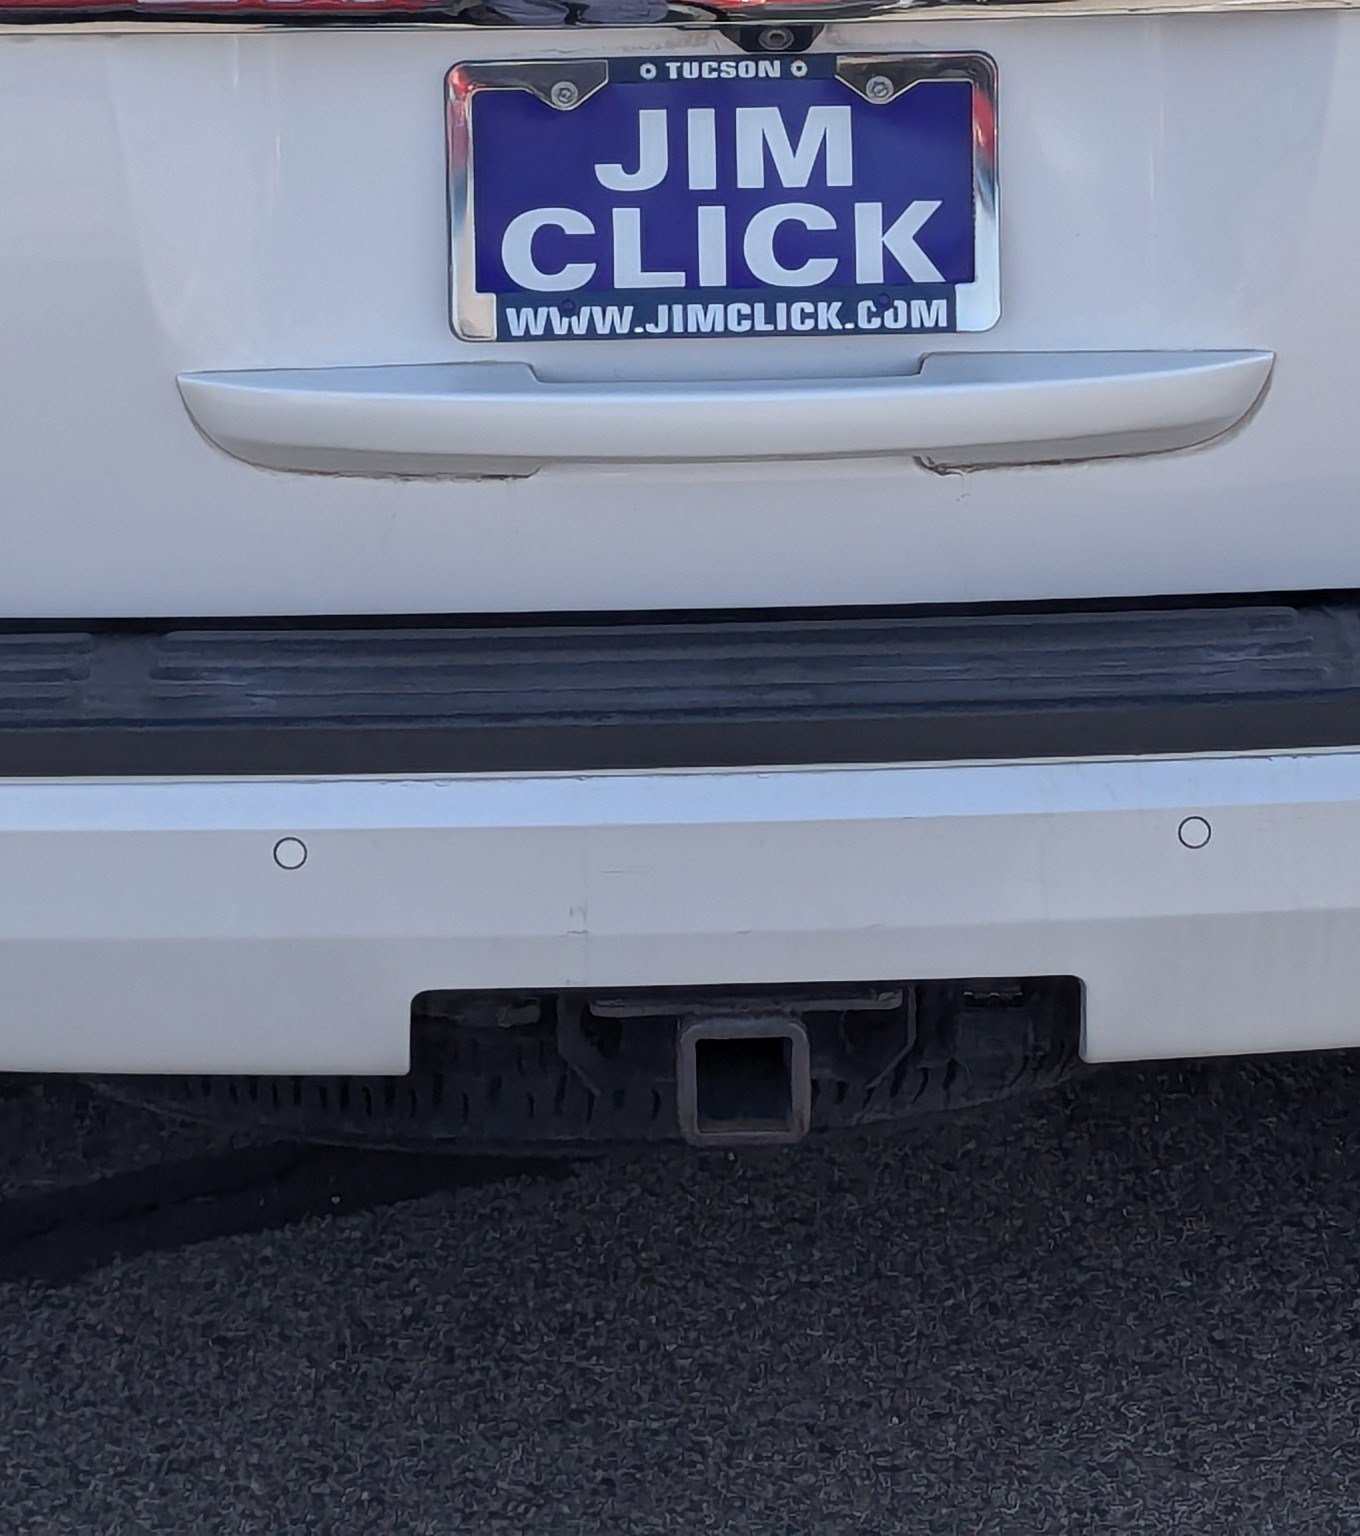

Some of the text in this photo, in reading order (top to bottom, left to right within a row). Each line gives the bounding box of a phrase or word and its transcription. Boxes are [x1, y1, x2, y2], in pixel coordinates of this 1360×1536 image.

[665, 60, 782, 79] TUCSON
[594, 106, 853, 191] JIM
[501, 200, 947, 292] CLICK
[505, 299, 949, 337] WWW.JIMCLICK.COM
